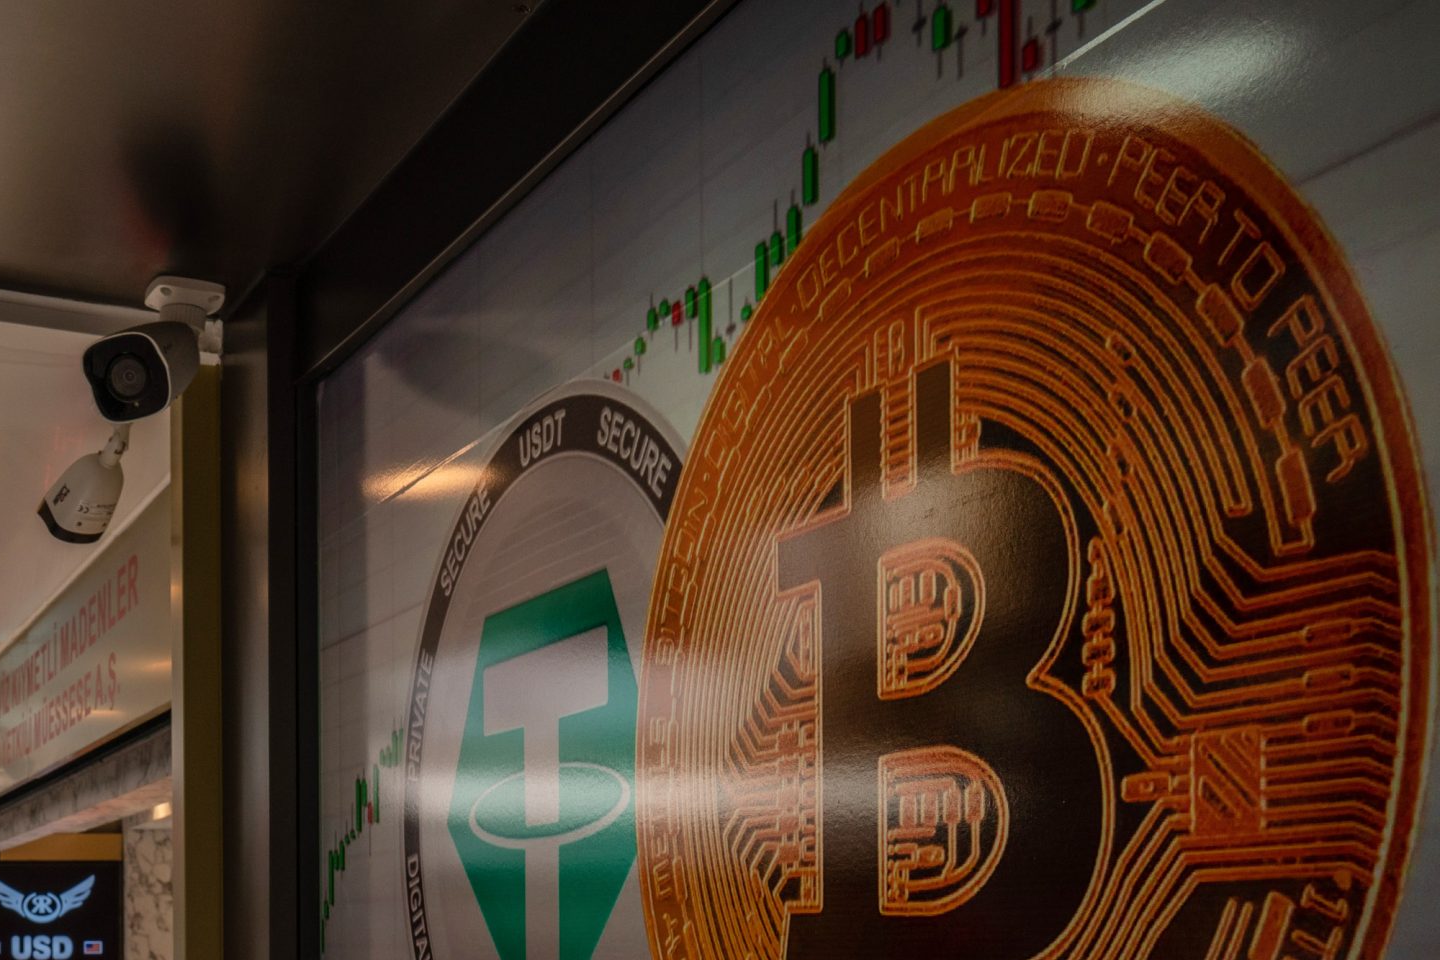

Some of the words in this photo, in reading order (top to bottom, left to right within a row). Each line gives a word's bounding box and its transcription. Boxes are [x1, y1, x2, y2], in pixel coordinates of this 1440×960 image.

[797, 130, 1096, 311] DECENTRALIZED
[1108, 134, 1225, 243] PEER
[1217, 208, 1286, 311] TO
[1267, 294, 1368, 482] PEER
[440, 487, 492, 596] SECURE
[518, 409, 566, 468] USDT
[597, 406, 672, 498] SECURE
[60, 553, 139, 669] MADENLER
[408, 650, 435, 783] PRIVATE
[11, 935, 74, 960] USD
